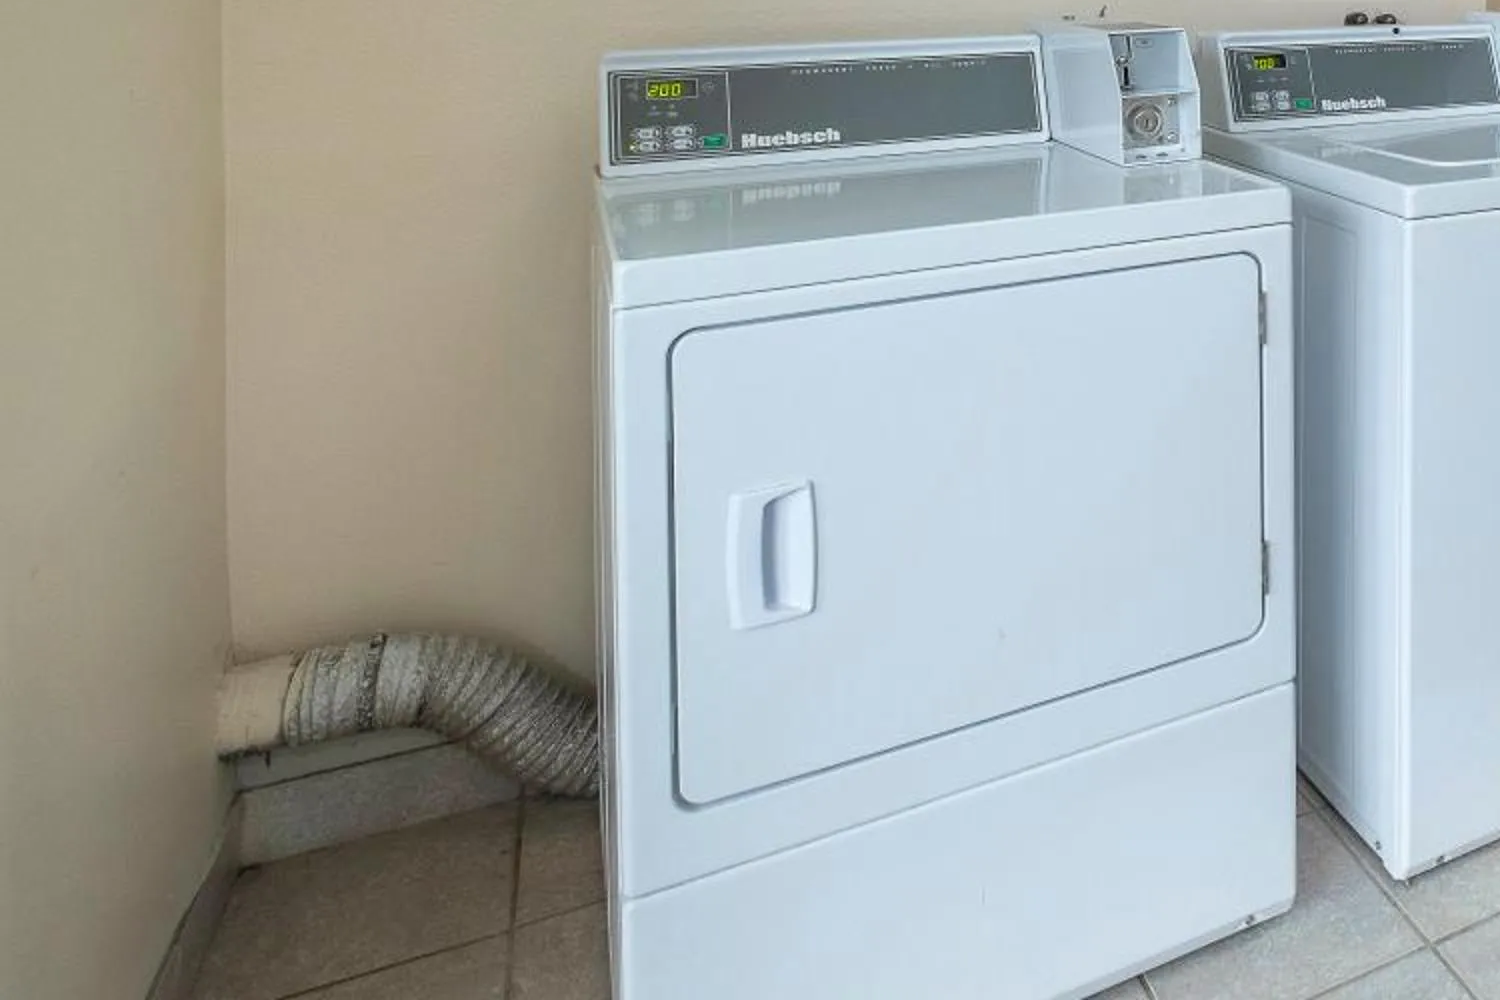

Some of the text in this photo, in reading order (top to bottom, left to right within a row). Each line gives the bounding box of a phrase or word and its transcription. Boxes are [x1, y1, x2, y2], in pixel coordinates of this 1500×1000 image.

[647, 83, 681, 97] 200
[1321, 96, 1387, 111] Huebsch
[741, 128, 840, 149] Huebsch
